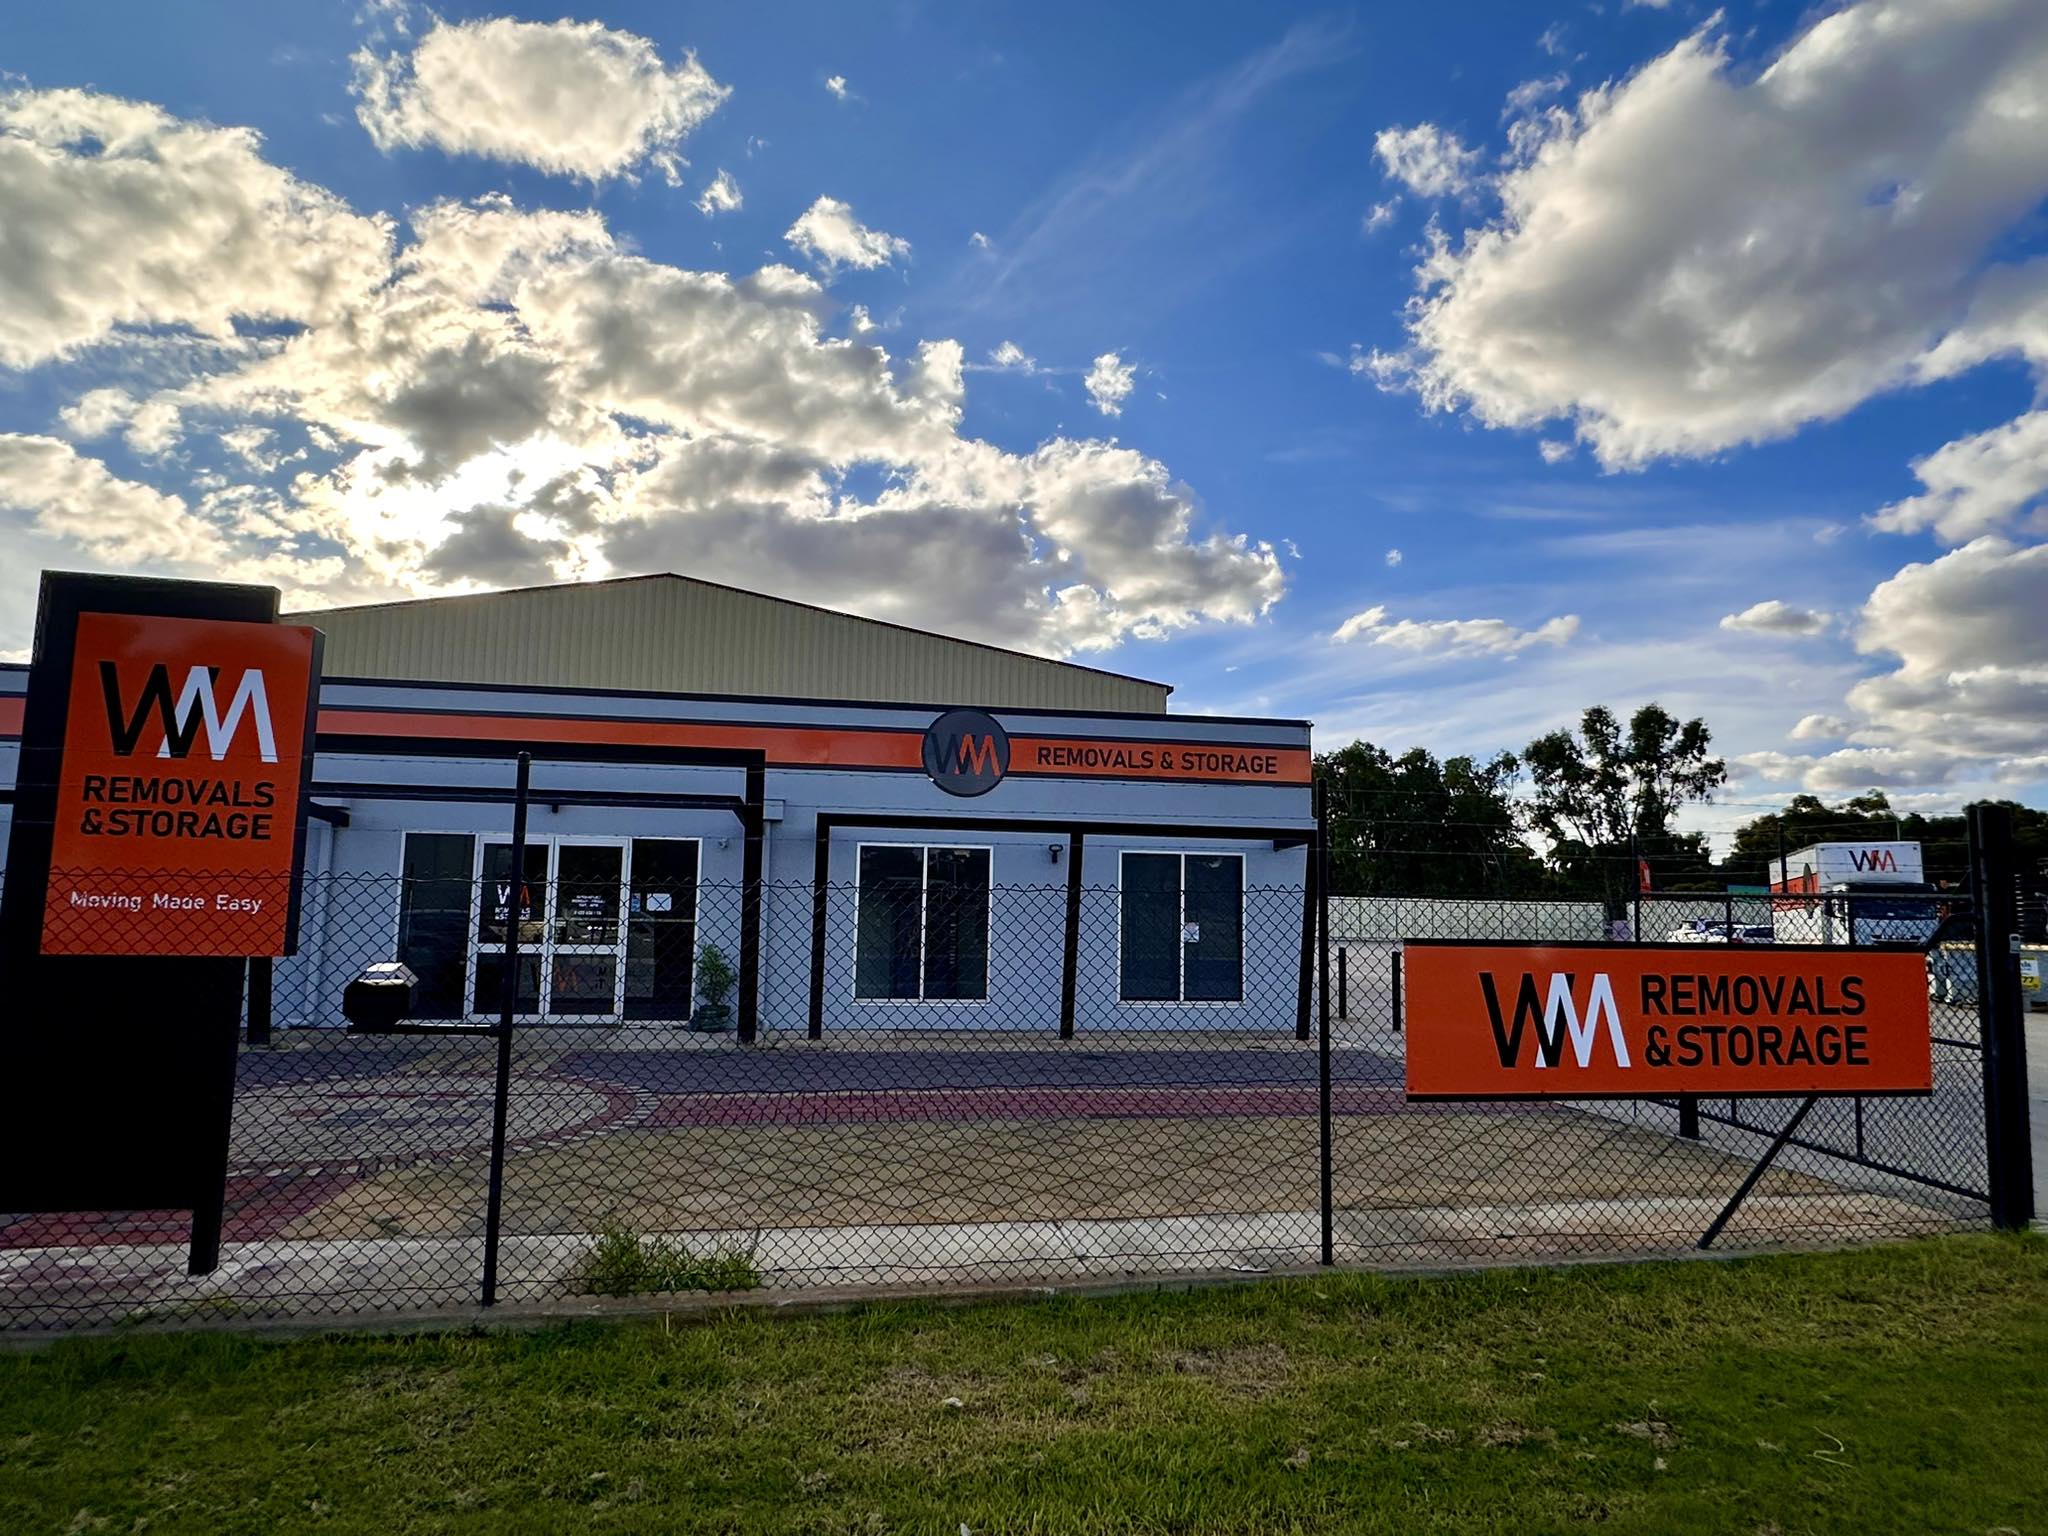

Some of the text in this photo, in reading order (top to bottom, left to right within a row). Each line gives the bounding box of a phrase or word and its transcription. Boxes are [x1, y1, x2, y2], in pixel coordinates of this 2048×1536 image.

[99, 661, 278, 763] WM
[1037, 747, 1277, 774] REMOVALS & STORAGE
[82, 775, 275, 808] REMOVALS
[70, 890, 262, 914] Moving Made Easy
[1641, 974, 1865, 1016] REMOVALS
[1478, 971, 1631, 1068] WM
